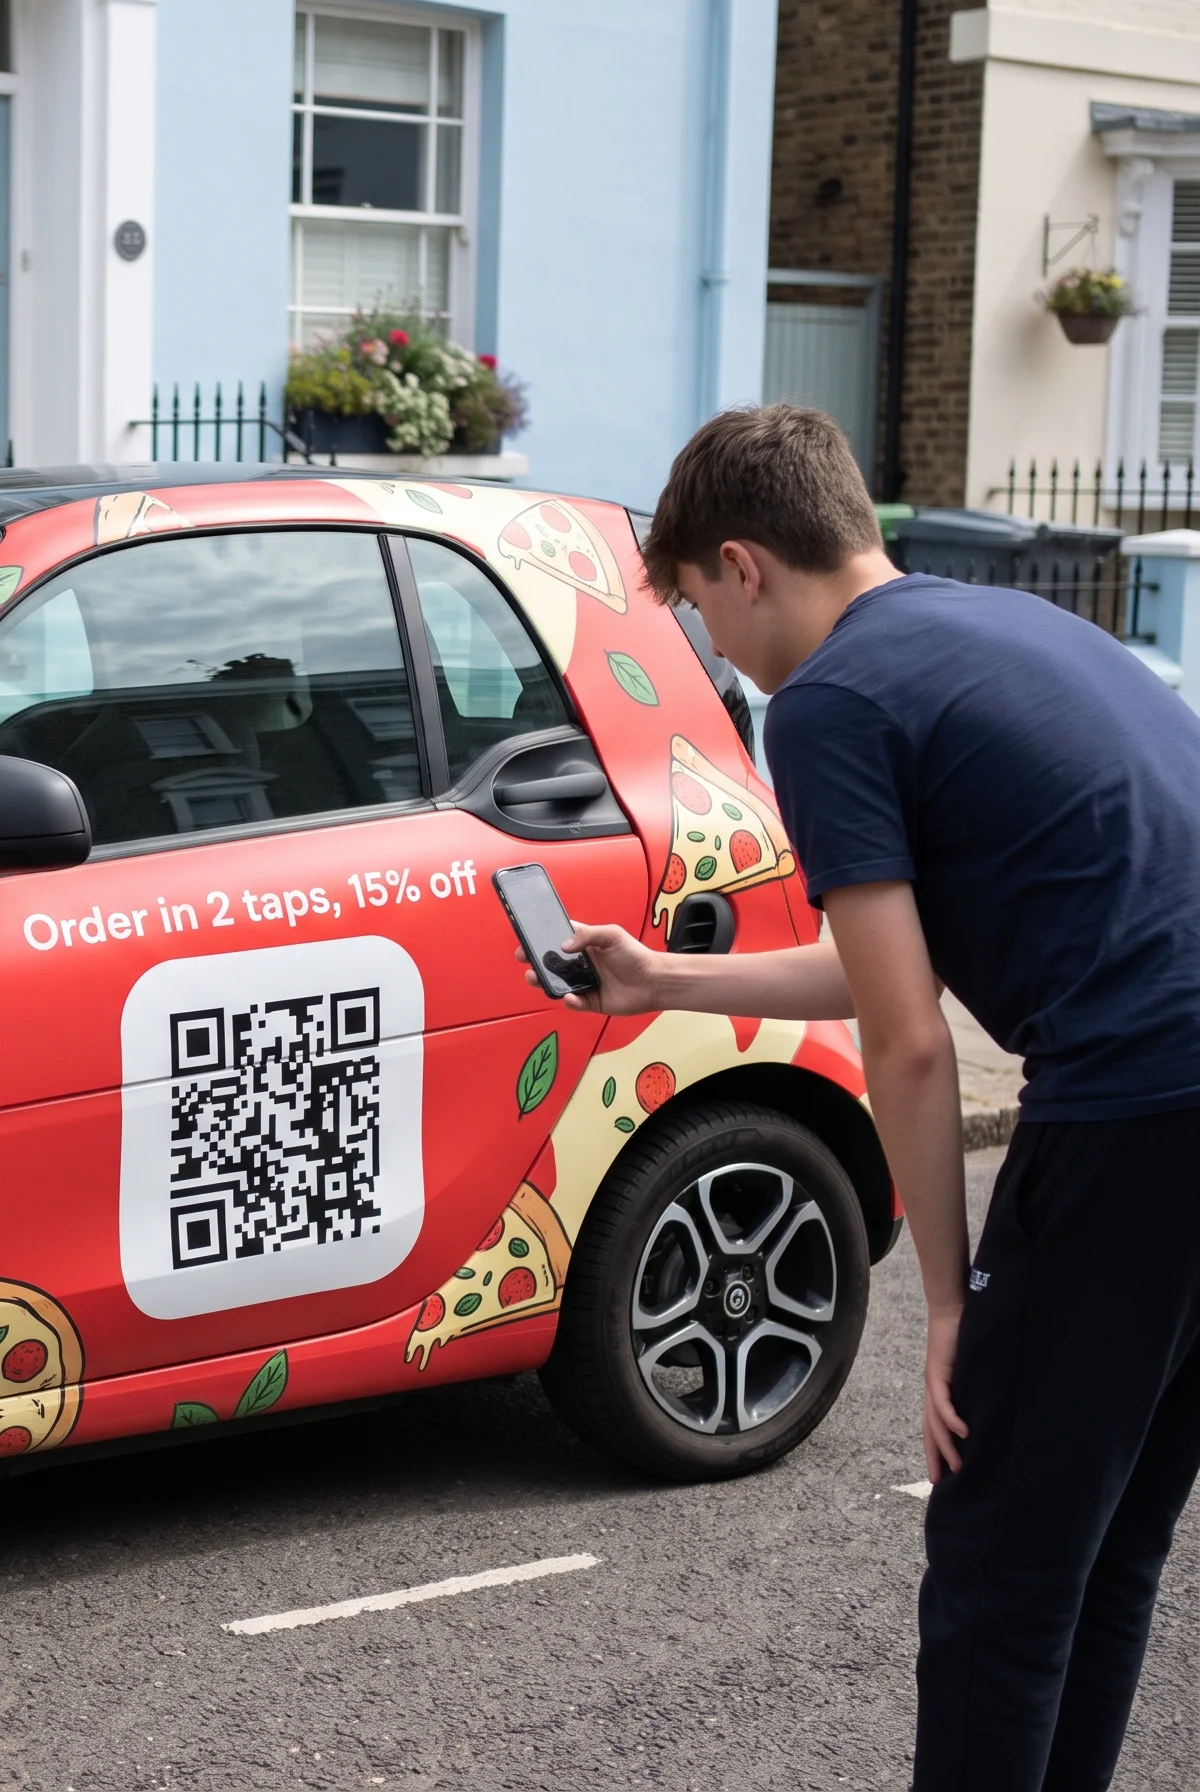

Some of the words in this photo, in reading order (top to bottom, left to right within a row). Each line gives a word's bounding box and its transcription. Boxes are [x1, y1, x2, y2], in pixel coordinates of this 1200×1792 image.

[23, 905, 149, 951] Order
[157, 896, 199, 934] in
[206, 890, 235, 927] 2
[241, 887, 342, 928] taps,
[347, 868, 421, 909] 15%
[429, 859, 478, 897] off
